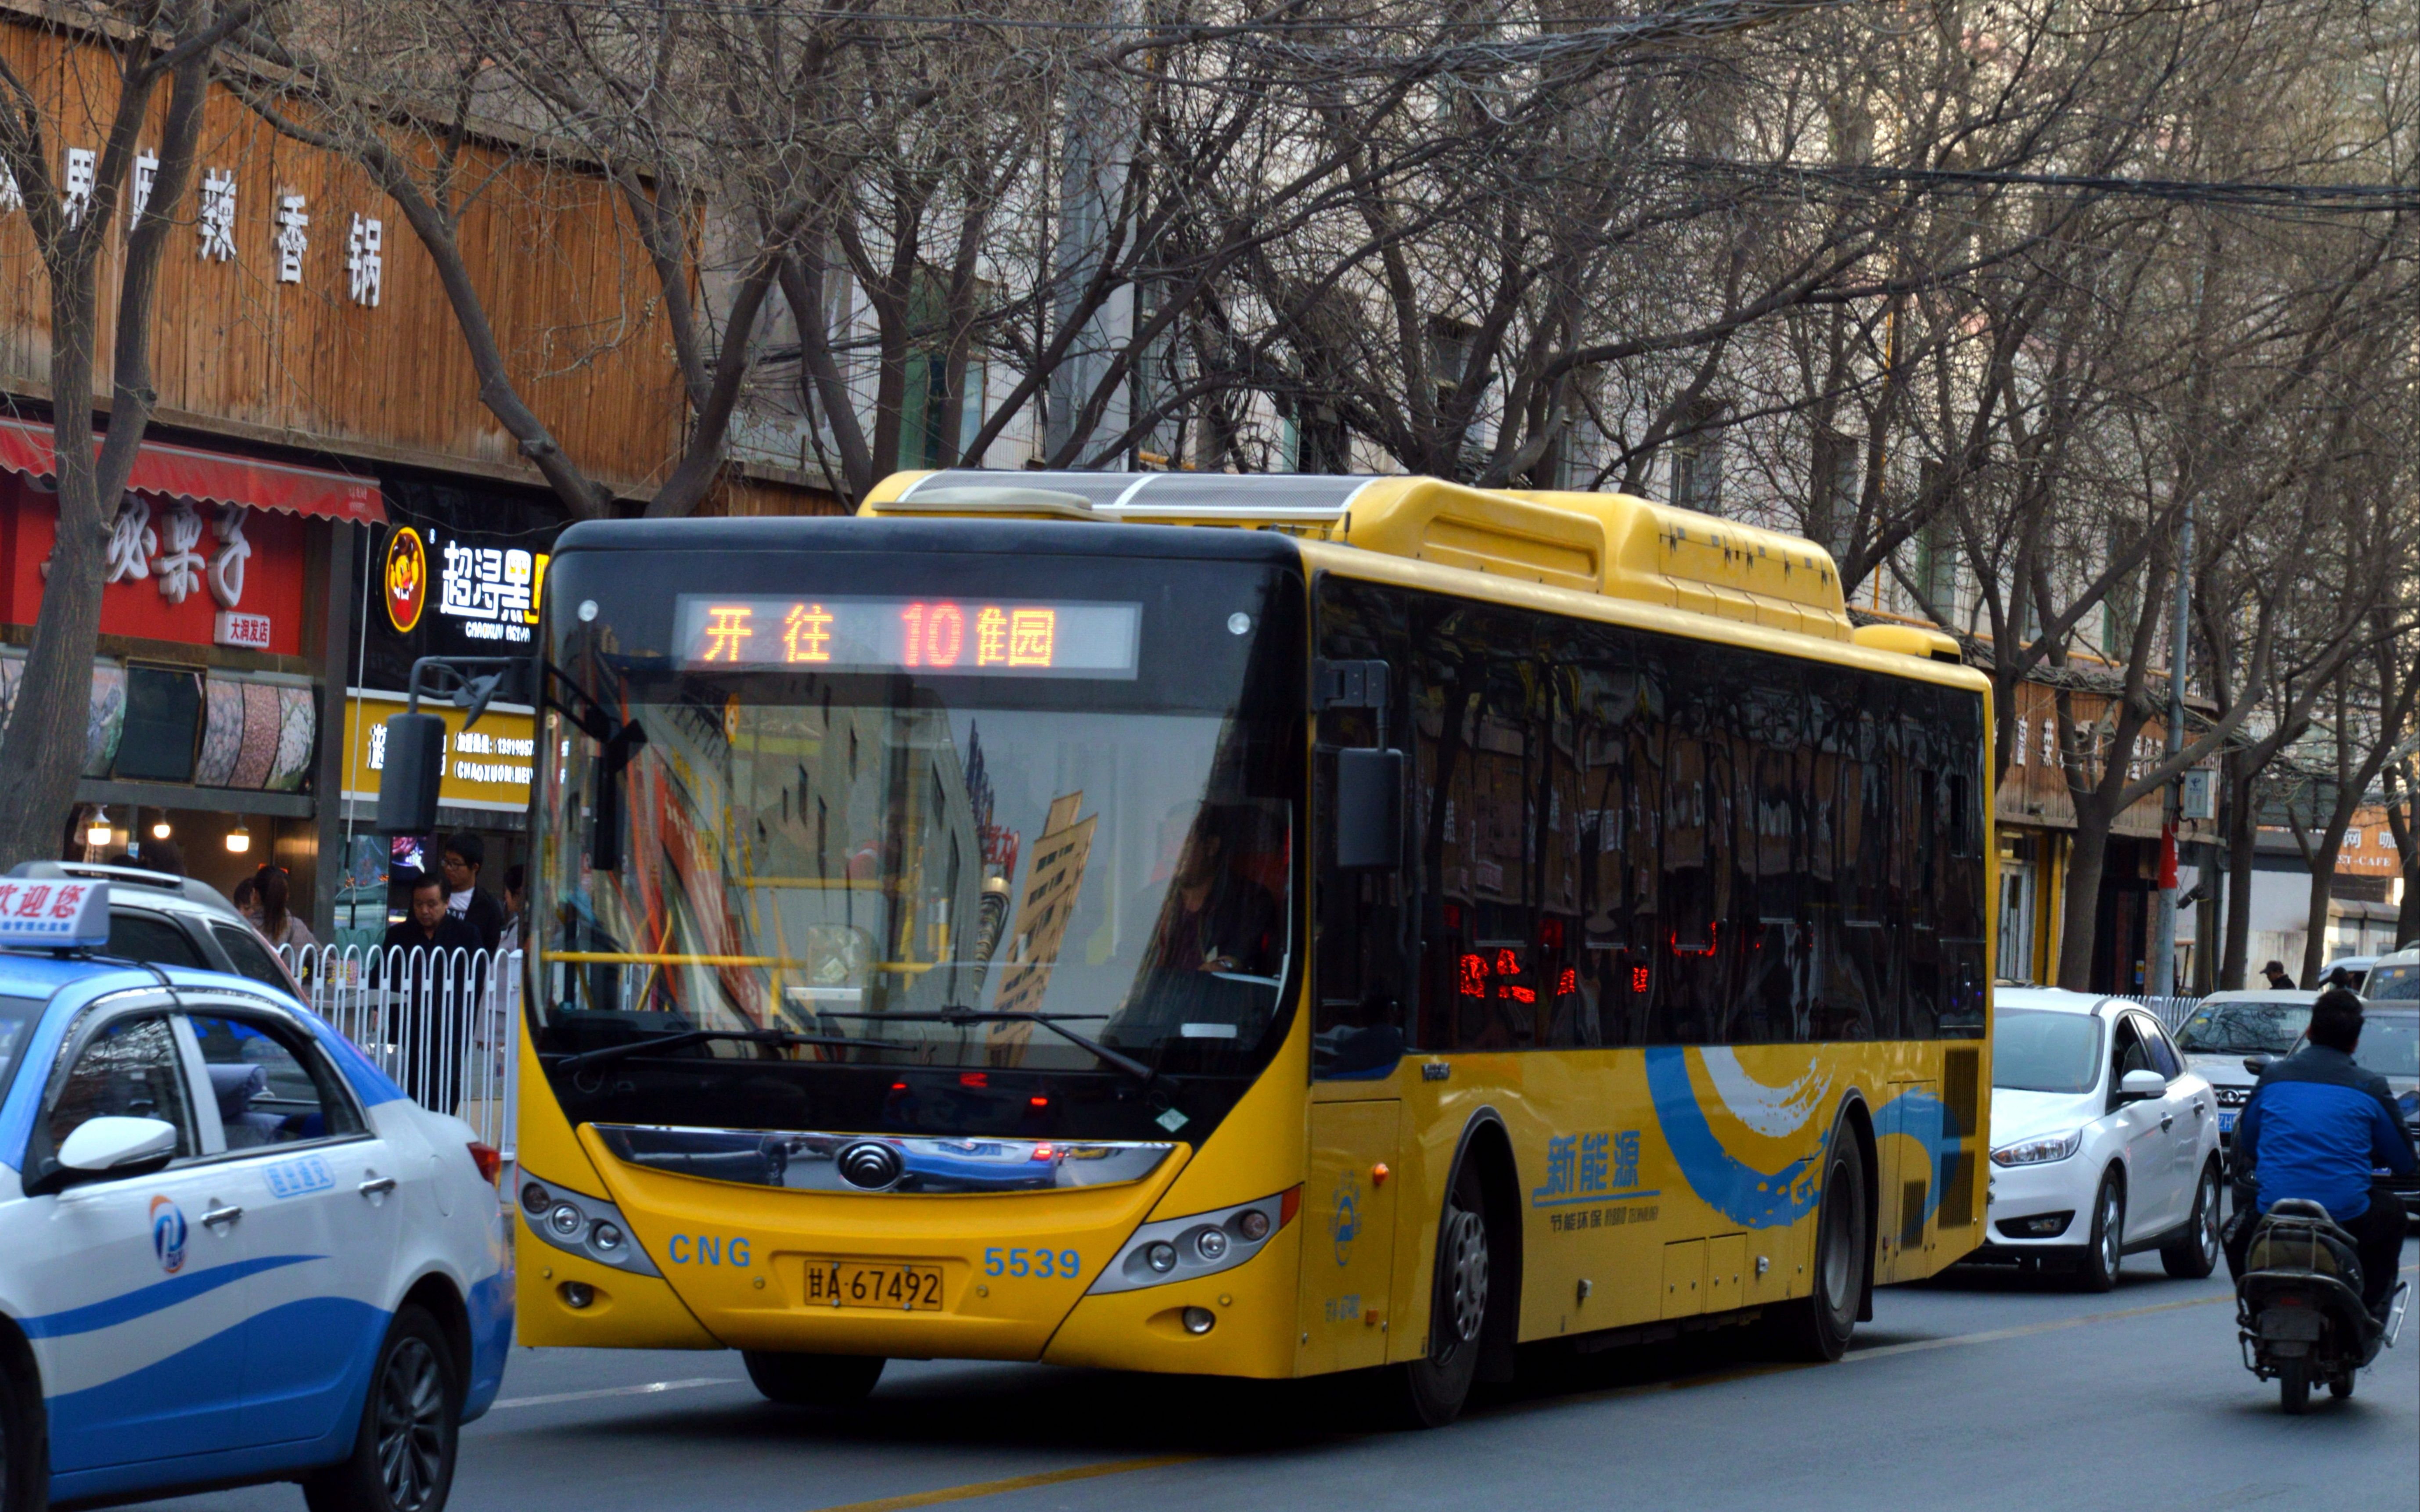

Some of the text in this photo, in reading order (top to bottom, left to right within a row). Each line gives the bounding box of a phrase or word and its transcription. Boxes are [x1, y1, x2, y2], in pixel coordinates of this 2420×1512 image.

[230, 618, 267, 643] 大润发店
[704, 603, 833, 662] 开往
[902, 603, 963, 666] 10
[1545, 1130, 1640, 1194] 新能源
[669, 1234, 750, 1267] CNG
[985, 1247, 1080, 1279] 5539
